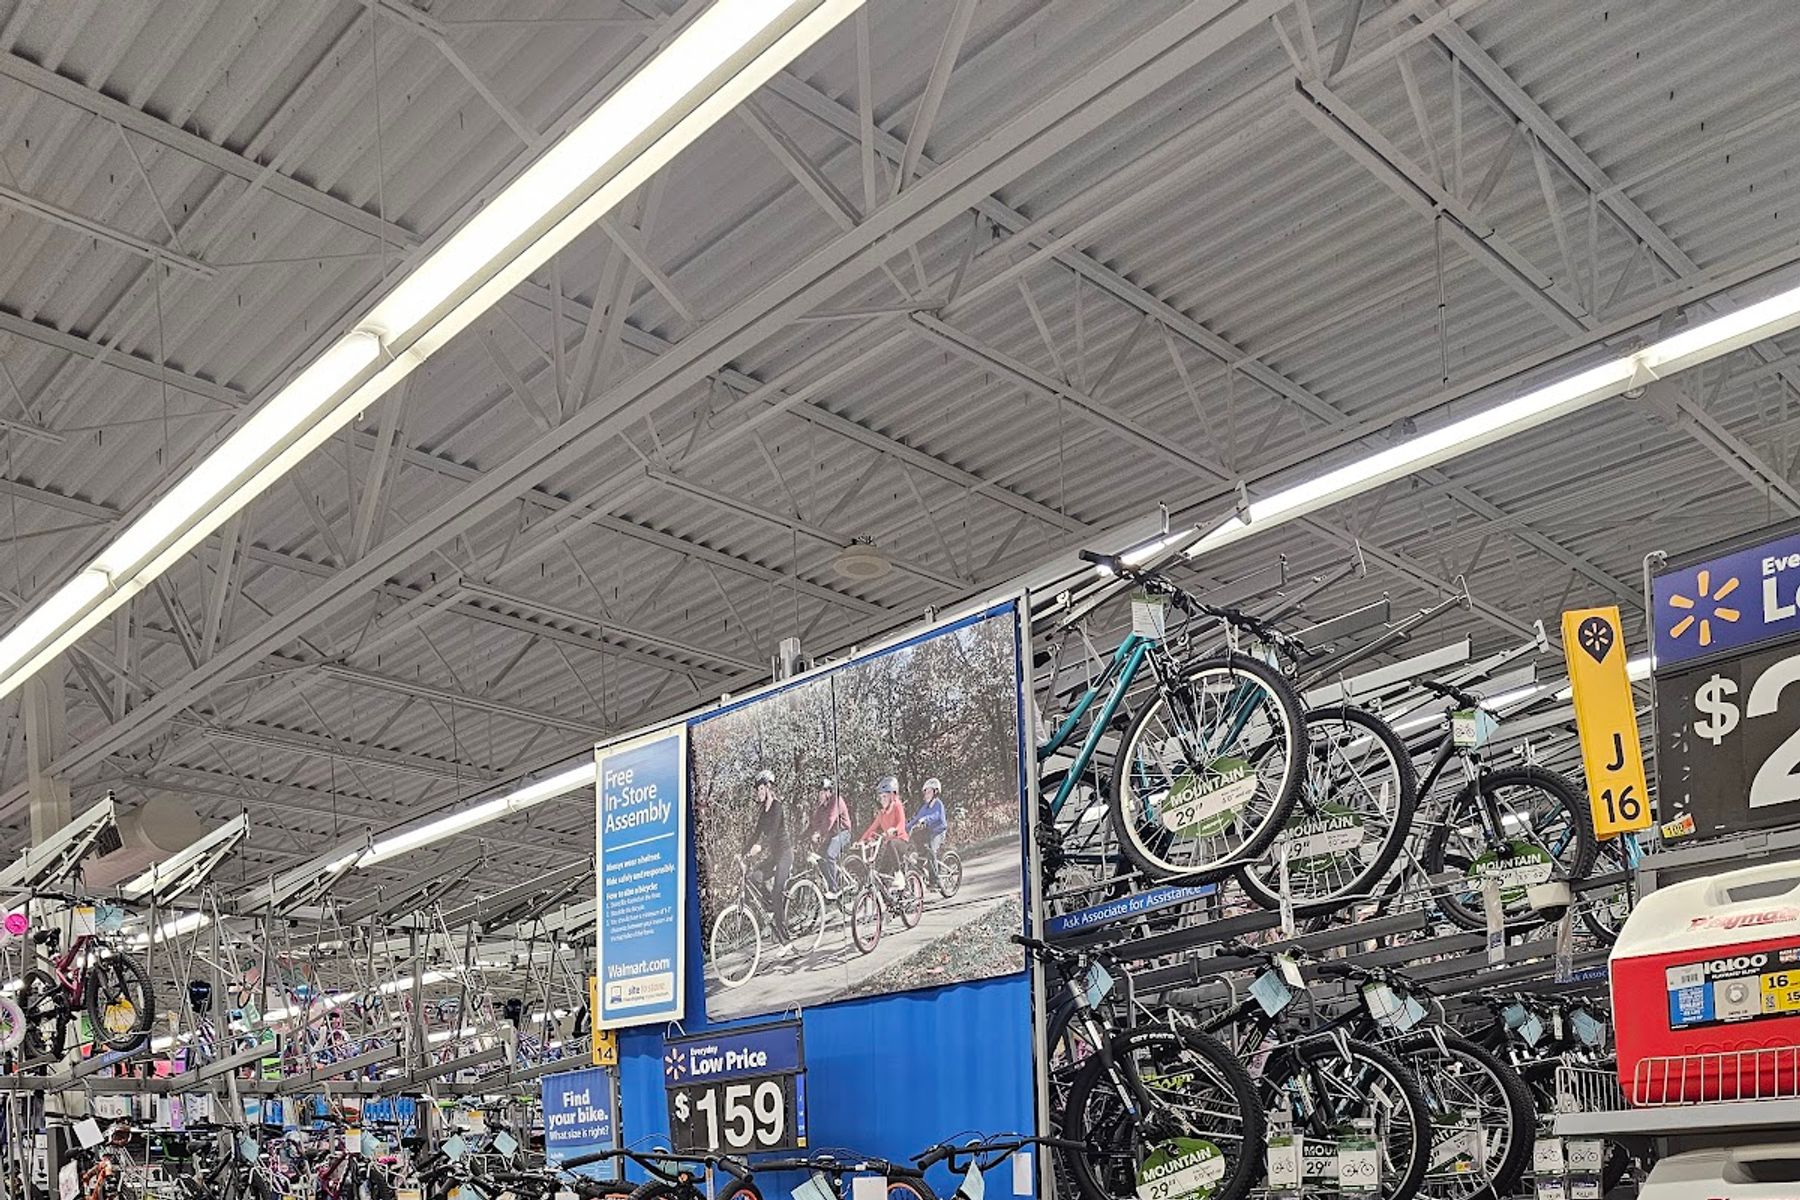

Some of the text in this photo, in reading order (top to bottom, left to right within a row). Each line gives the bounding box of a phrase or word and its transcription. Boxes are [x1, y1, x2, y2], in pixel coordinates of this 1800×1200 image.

[1606, 733, 1624, 772] J
[605, 768, 634, 790] Free
[1170, 766, 1245, 808] MOUNTAIN
[605, 783, 657, 812] In-Store
[1601, 785, 1641, 823] 16
[605, 799, 672, 834] Assembly
[1476, 853, 1541, 873] MOUNTAIN
[1063, 886, 1201, 929] Ask Associate for Assistance
[608, 958, 670, 978] Walmart.com
[1704, 954, 1768, 974] IGLOO
[1769, 975, 1789, 988] 16
[597, 1047, 613, 1061] 14
[690, 1045, 717, 1056] Everyday
[690, 1047, 767, 1075] Low Price
[562, 1089, 590, 1108] Find
[548, 1105, 608, 1130] your bike.
[549, 1125, 609, 1140] What size is right?
[1142, 1147, 1212, 1181] MOUNTAIN
